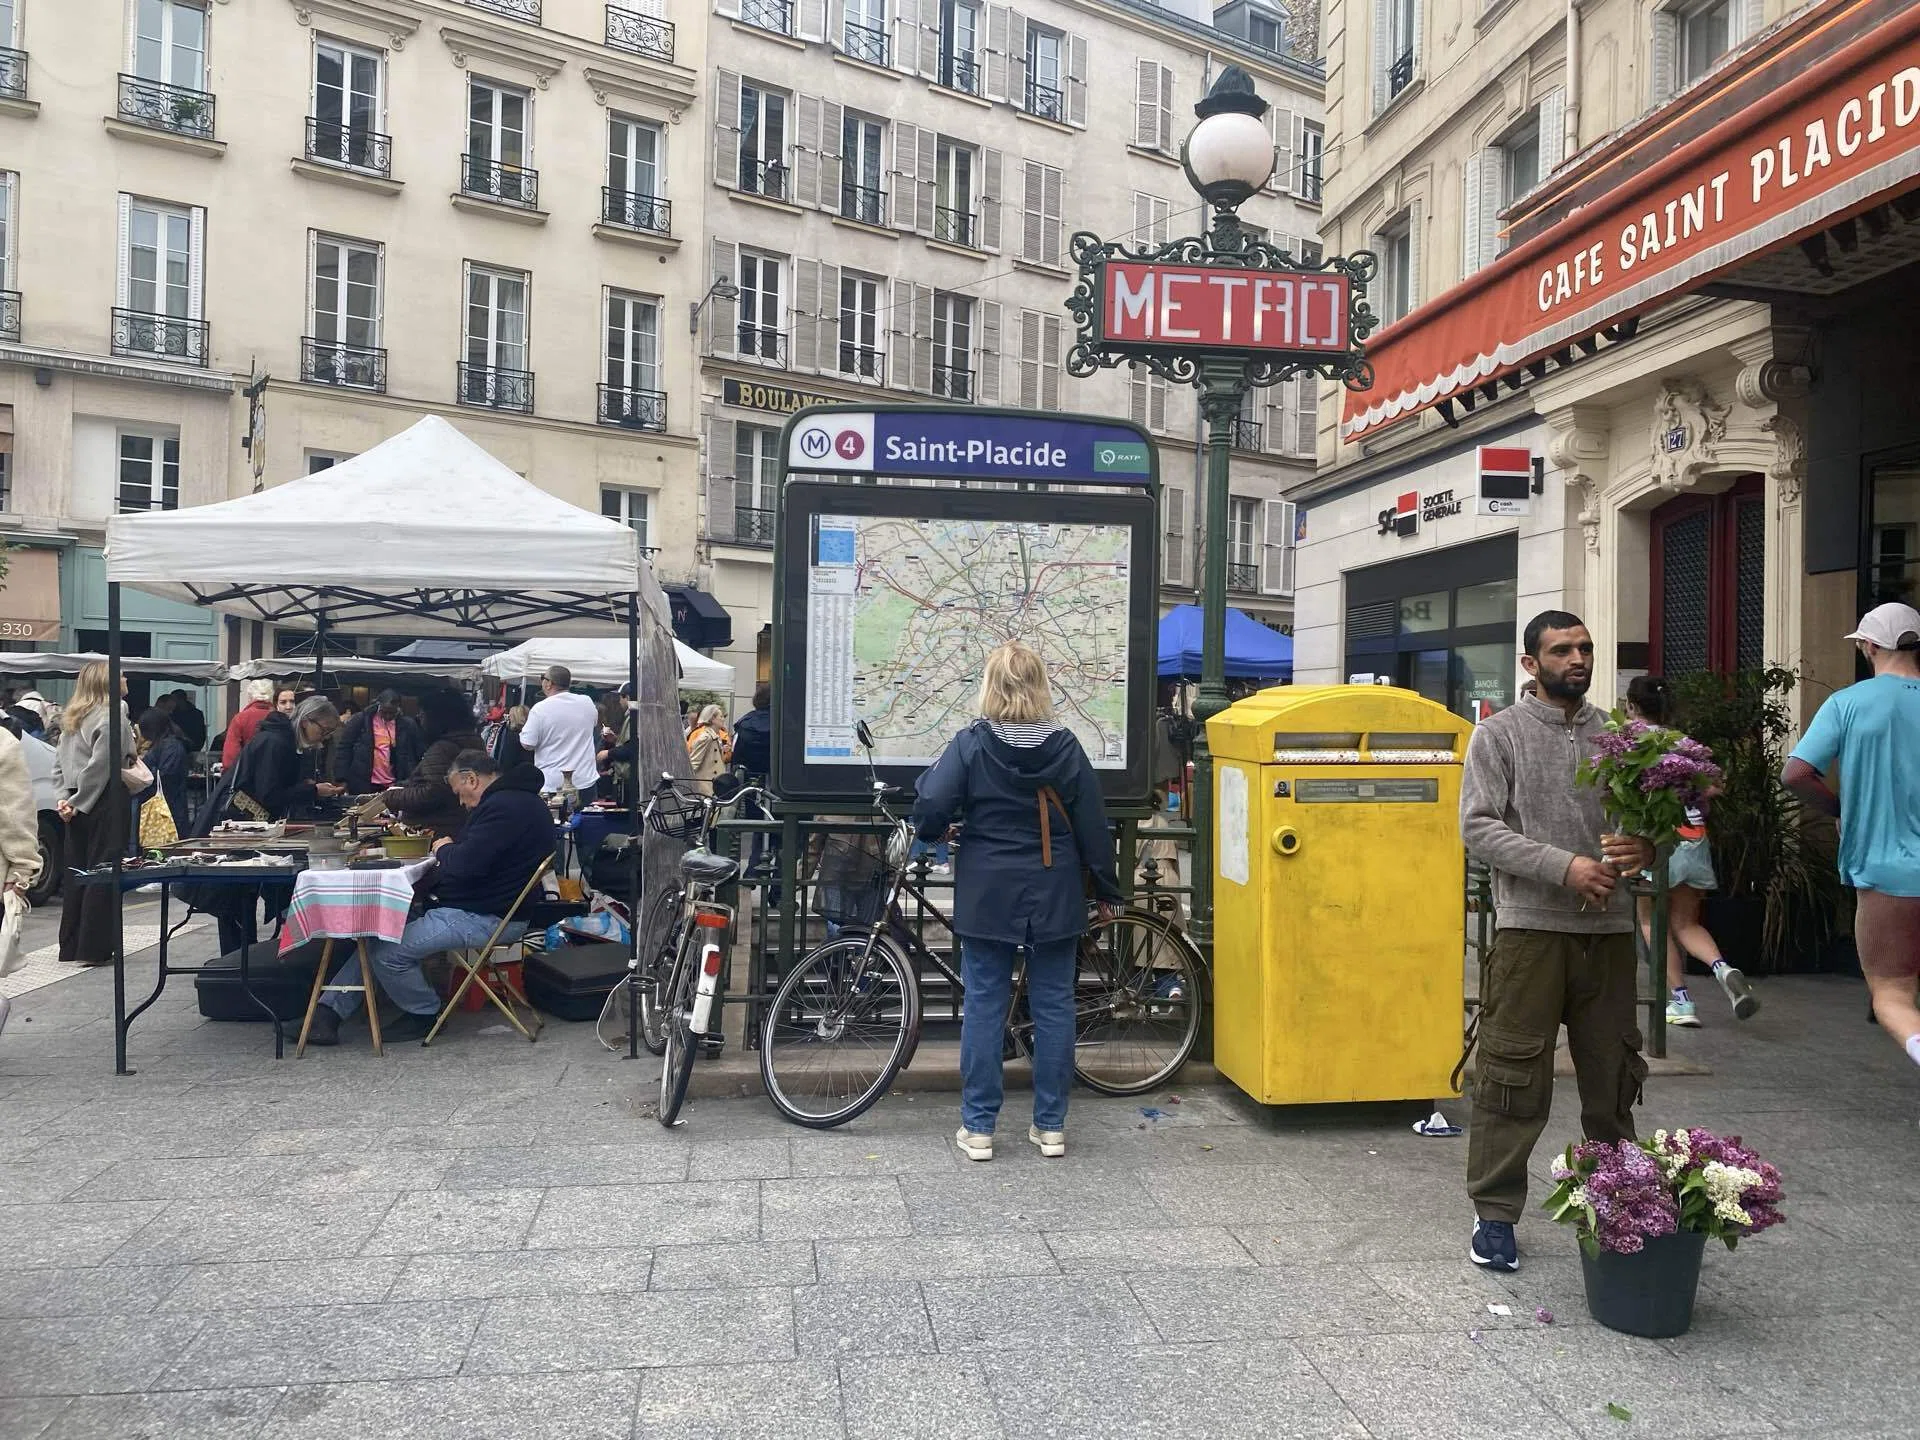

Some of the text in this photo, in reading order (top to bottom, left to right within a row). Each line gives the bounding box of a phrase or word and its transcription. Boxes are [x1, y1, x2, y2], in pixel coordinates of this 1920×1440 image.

[1538, 240, 1605, 313] CAFE
[1620, 171, 1729, 271] SAINT
[1113, 269, 1340, 346] METRO
[807, 435, 1067, 467] M 4 Saint-Placide
[1377, 507, 1397, 536] SG
